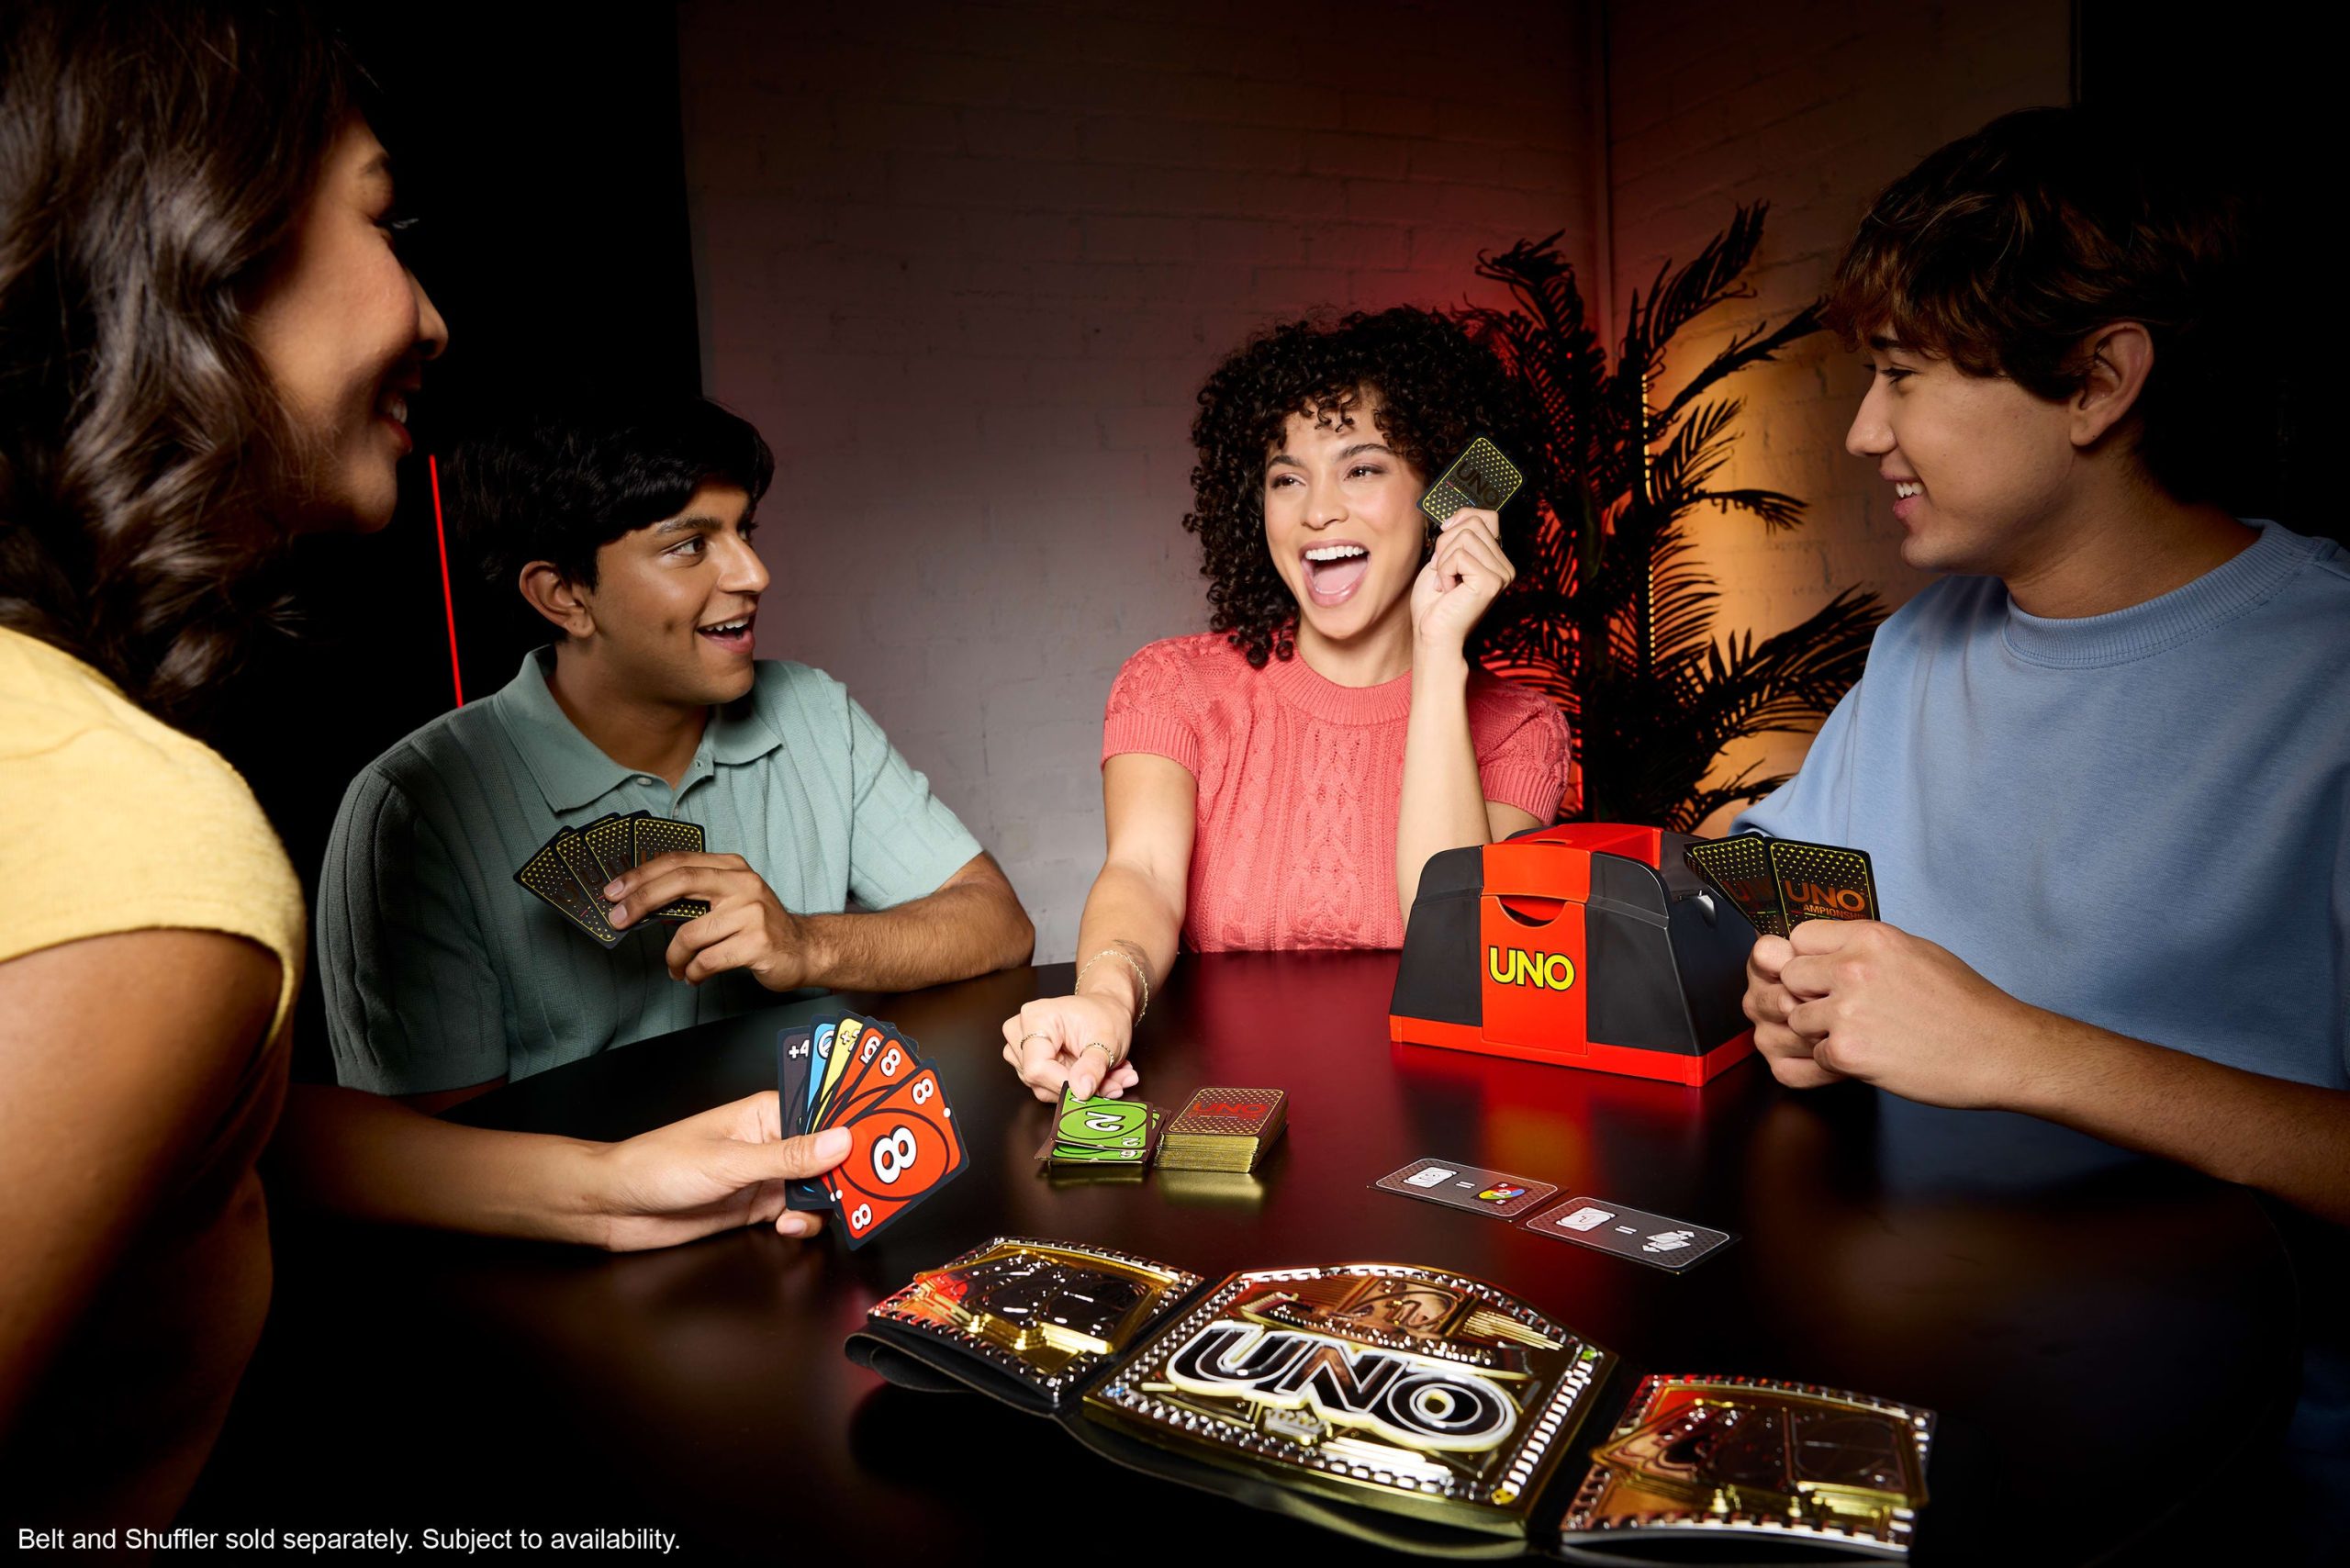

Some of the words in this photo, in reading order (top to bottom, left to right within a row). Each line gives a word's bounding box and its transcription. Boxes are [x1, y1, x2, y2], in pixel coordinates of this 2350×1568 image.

[1785, 879, 1865, 912] UNO
[1487, 946, 1576, 991] UNO
[880, 1047, 901, 1077] 8
[912, 1078, 934, 1105] 8
[1084, 1111, 1125, 1133] 2
[1192, 1102, 1267, 1114] UNO
[871, 1125, 917, 1184] 8
[851, 1203, 873, 1231] 8
[1167, 1320, 1516, 1450] UNO
